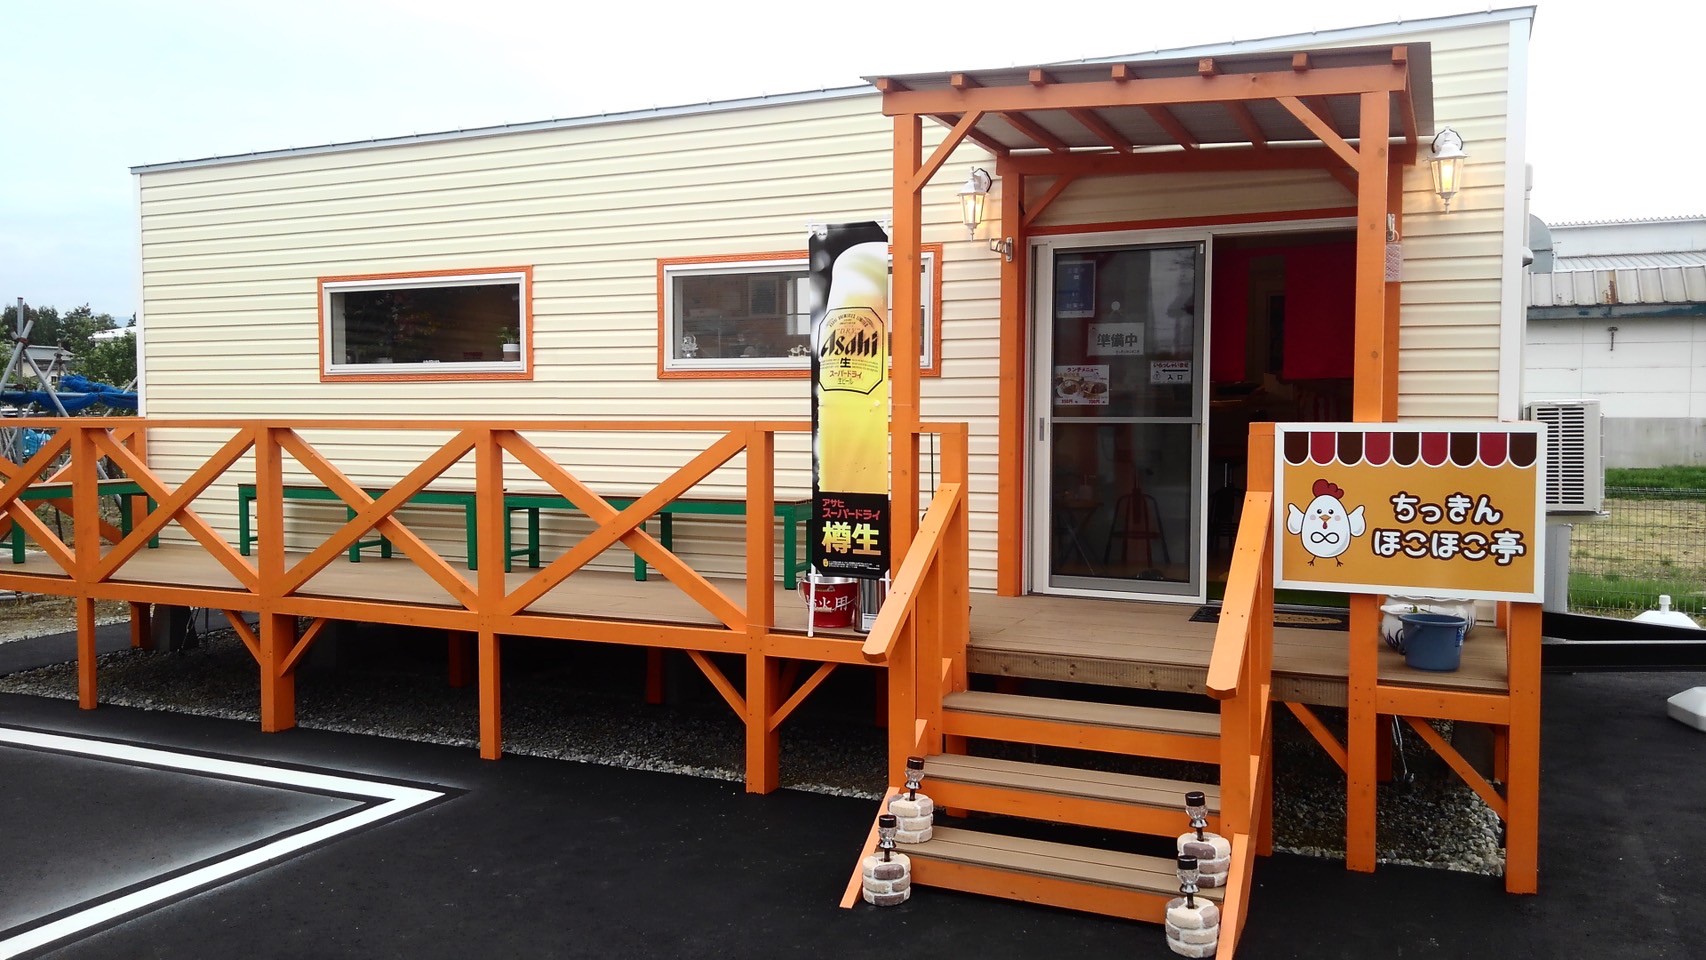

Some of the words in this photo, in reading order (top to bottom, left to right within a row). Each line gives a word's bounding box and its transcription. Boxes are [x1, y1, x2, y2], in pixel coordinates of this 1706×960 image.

[821, 329, 878, 358] Asahi
[1096, 333, 1138, 347] 準備中
[840, 357, 851, 368] 生
[829, 370, 863, 379] スーパードライ
[822, 499, 845, 508] アサヒ
[1389, 491, 1504, 525] ちっきん
[822, 507, 881, 520] スーパードライ
[821, 520, 881, 555] 樽生
[1371, 528, 1527, 566] ほこほこ亭
